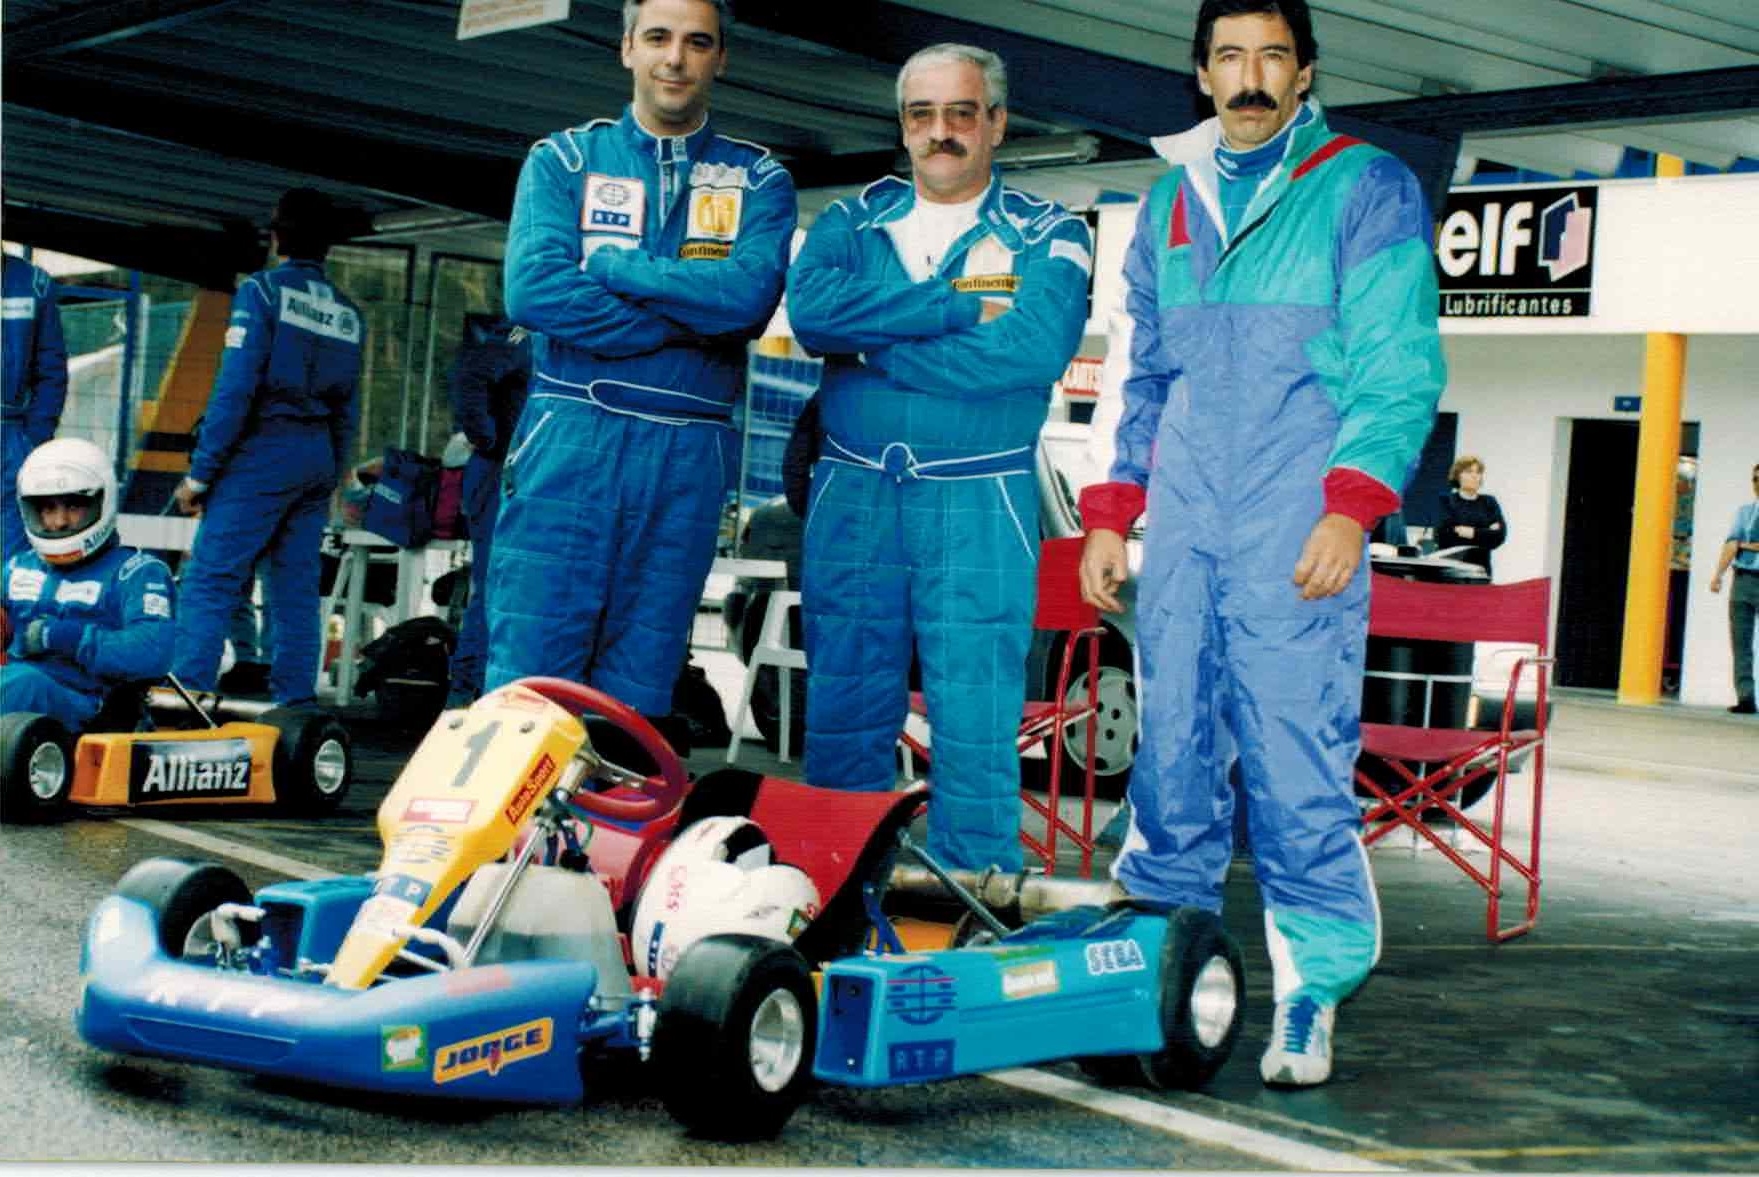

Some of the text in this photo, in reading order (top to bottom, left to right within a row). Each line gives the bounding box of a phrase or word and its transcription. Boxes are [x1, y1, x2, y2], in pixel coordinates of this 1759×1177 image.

[1438, 201, 1534, 277] elf
[1445, 293, 1573, 315] Lubrificantes
[142, 754, 250, 792] Allianz
[1087, 939, 1145, 975] SEGA
[440, 1027, 545, 1071] JORGE
